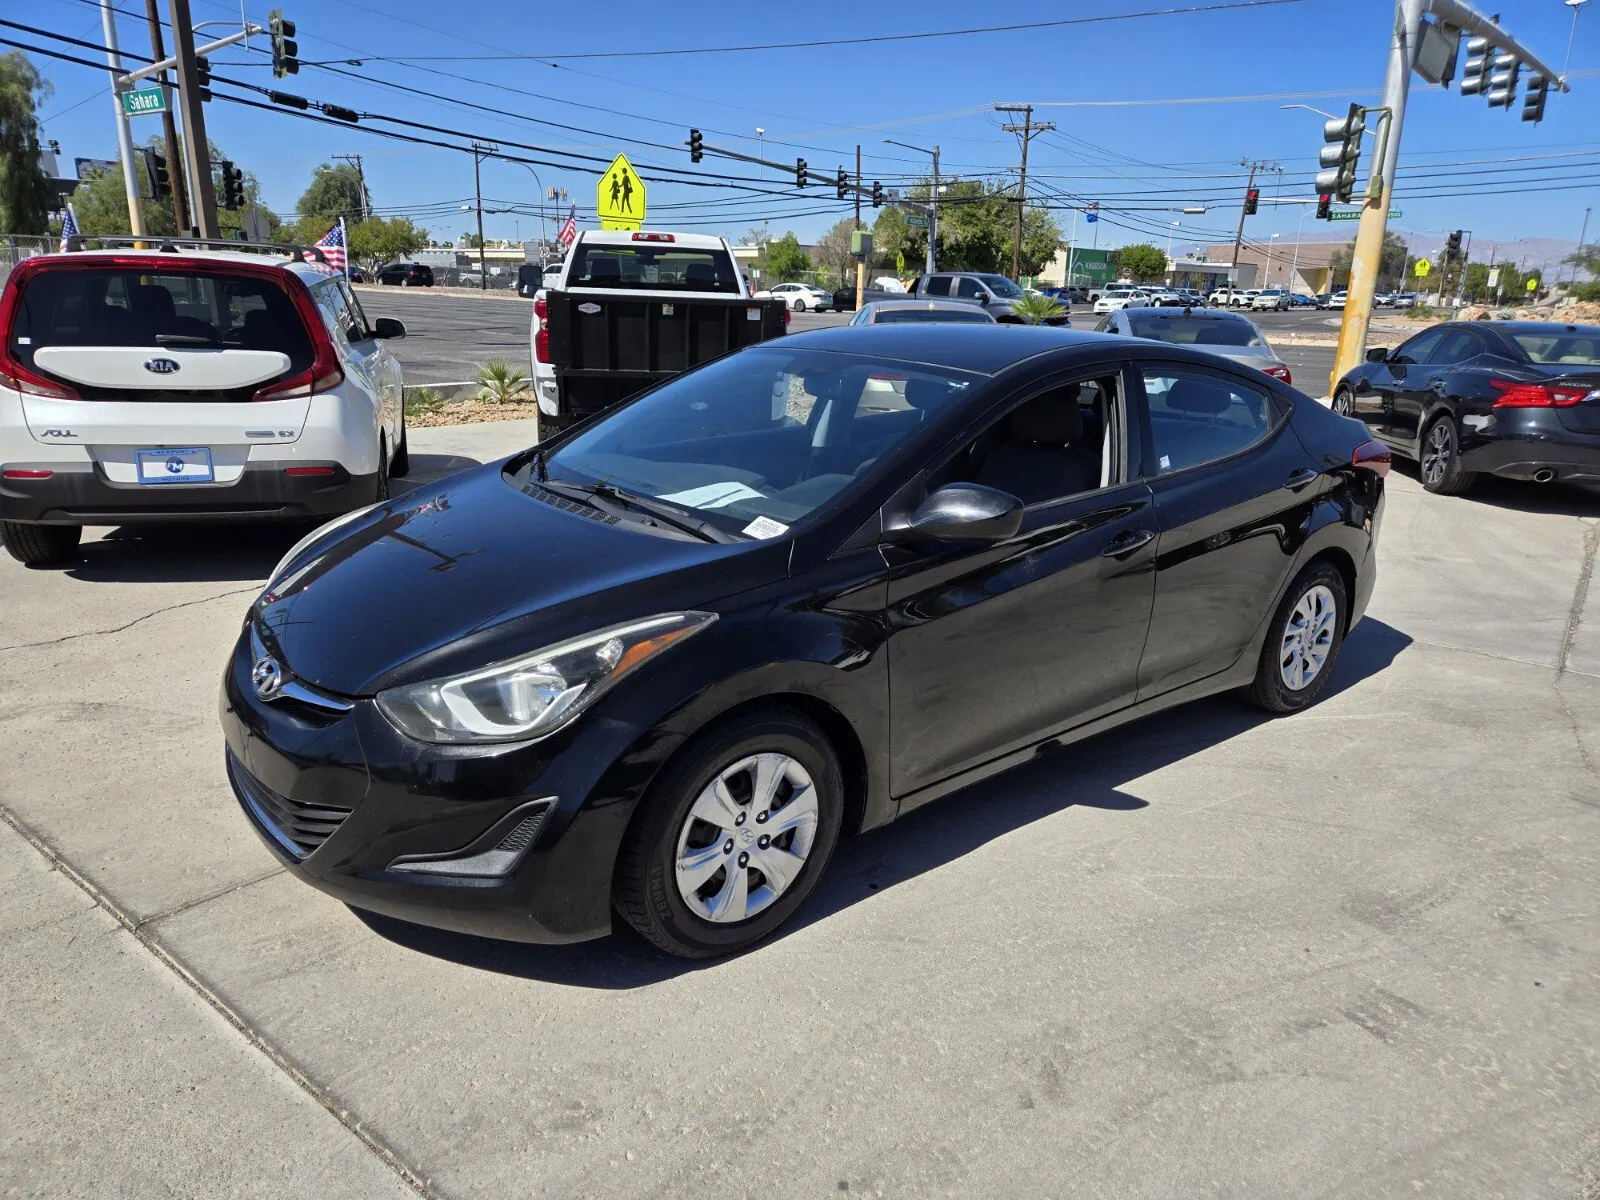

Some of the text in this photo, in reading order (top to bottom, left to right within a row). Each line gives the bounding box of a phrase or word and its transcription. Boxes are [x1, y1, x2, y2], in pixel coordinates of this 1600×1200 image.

[129, 93, 159, 110] Sahara
[150, 361, 176, 371] KIA
[40, 429, 79, 437] SOUL
[278, 430, 295, 438] EX
